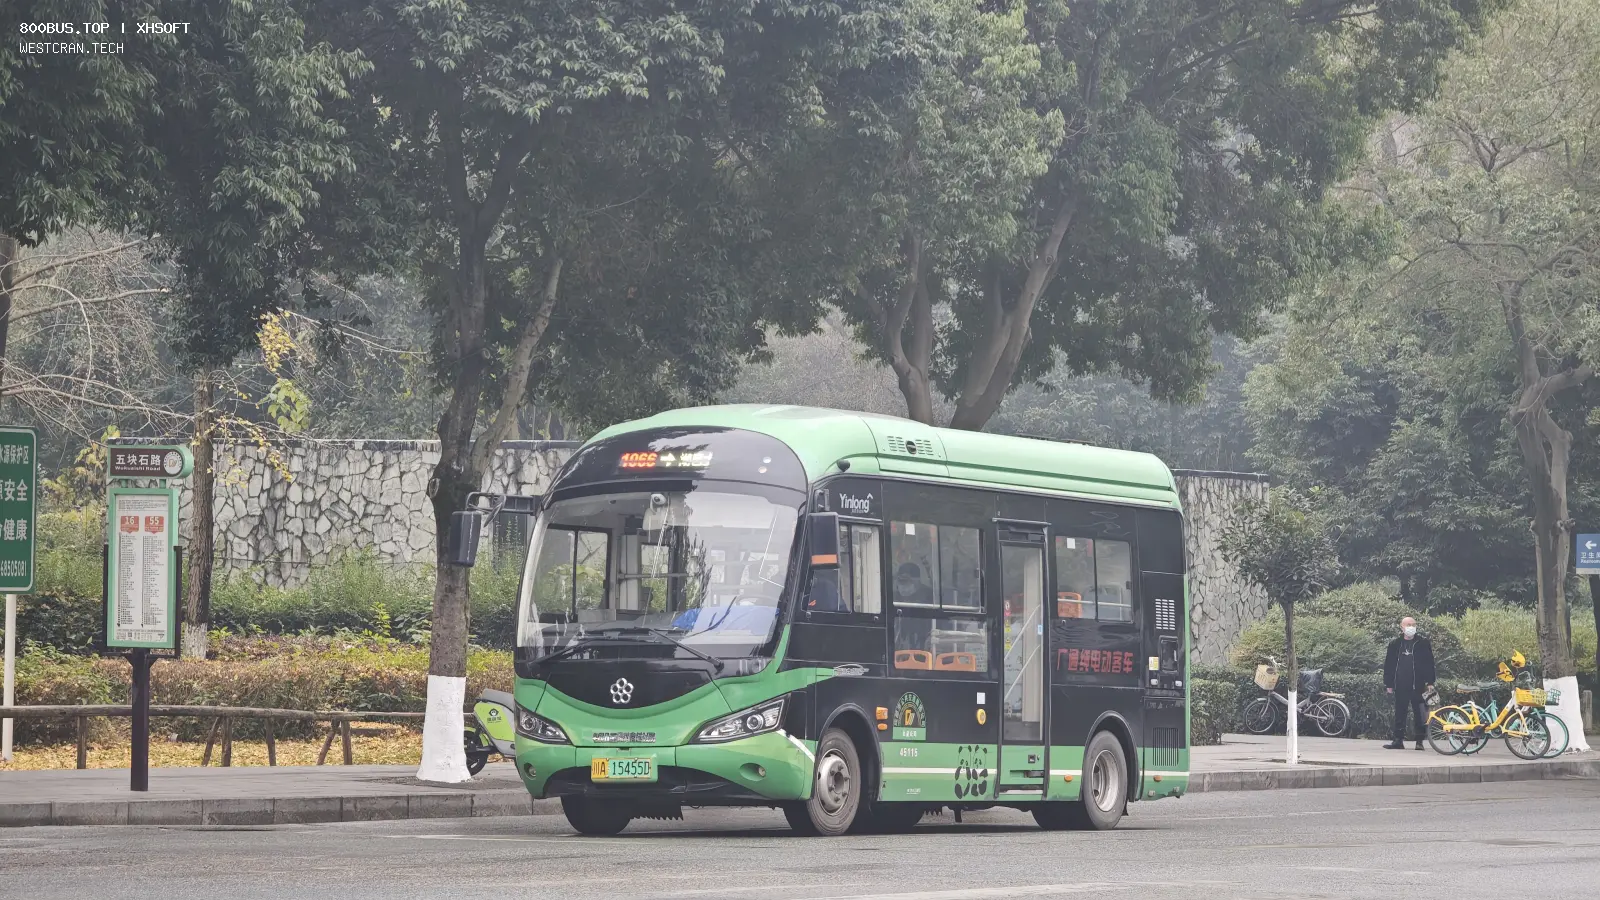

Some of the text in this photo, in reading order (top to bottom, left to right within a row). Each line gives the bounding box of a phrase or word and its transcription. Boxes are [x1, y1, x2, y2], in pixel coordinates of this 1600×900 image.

[115, 453, 161, 466] 五块石路
[621, 452, 658, 468] 1066
[0, 478, 28, 501] 安全
[839, 493, 870, 513] Yinlong
[125, 516, 135, 525] 16
[149, 516, 160, 525] 55
[0, 518, 28, 541] 健康
[899, 747, 918, 757] 45115
[611, 761, 650, 776] 15455D
